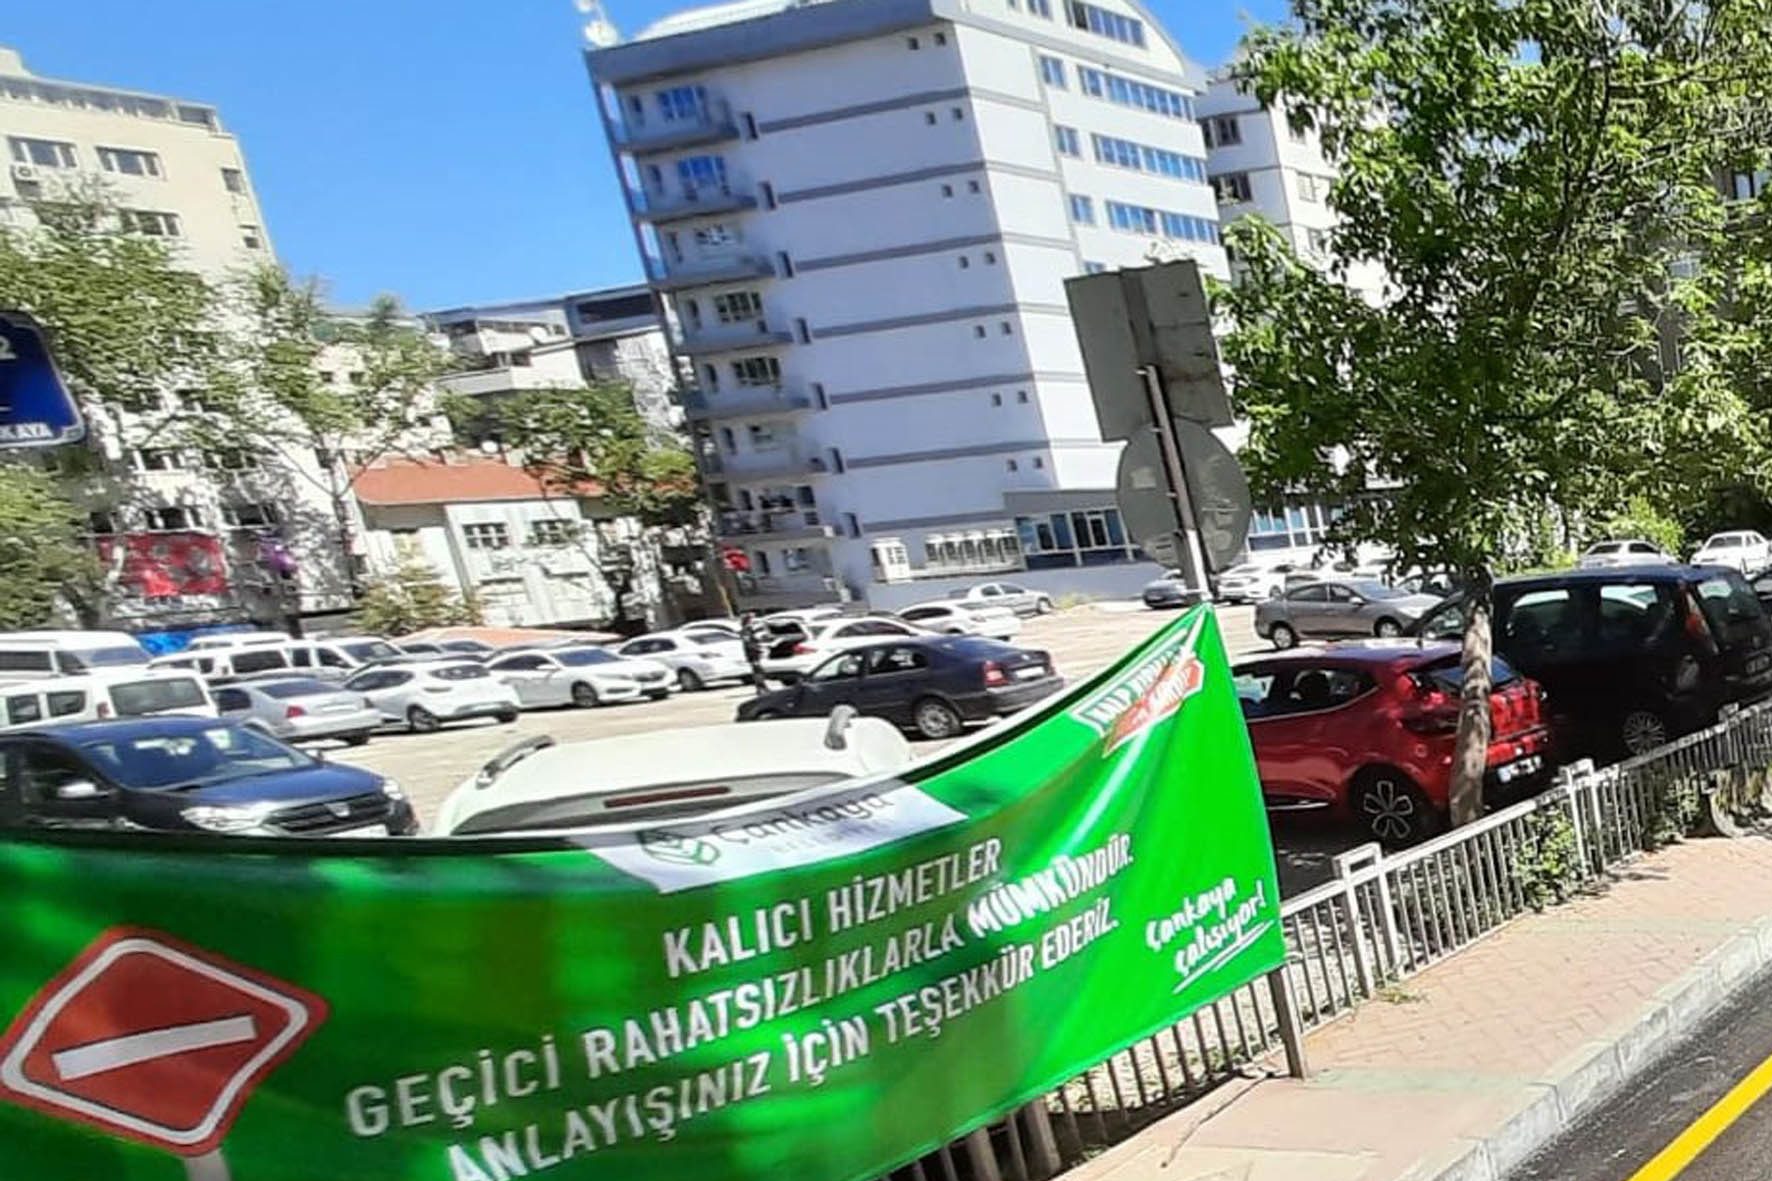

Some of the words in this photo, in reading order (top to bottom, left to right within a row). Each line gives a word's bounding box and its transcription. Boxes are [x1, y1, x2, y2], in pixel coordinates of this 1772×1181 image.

[664, 898, 813, 979] KALICI
[827, 838, 1001, 933] HİZMETLER
[345, 1034, 562, 1129] GEÇİCİ
